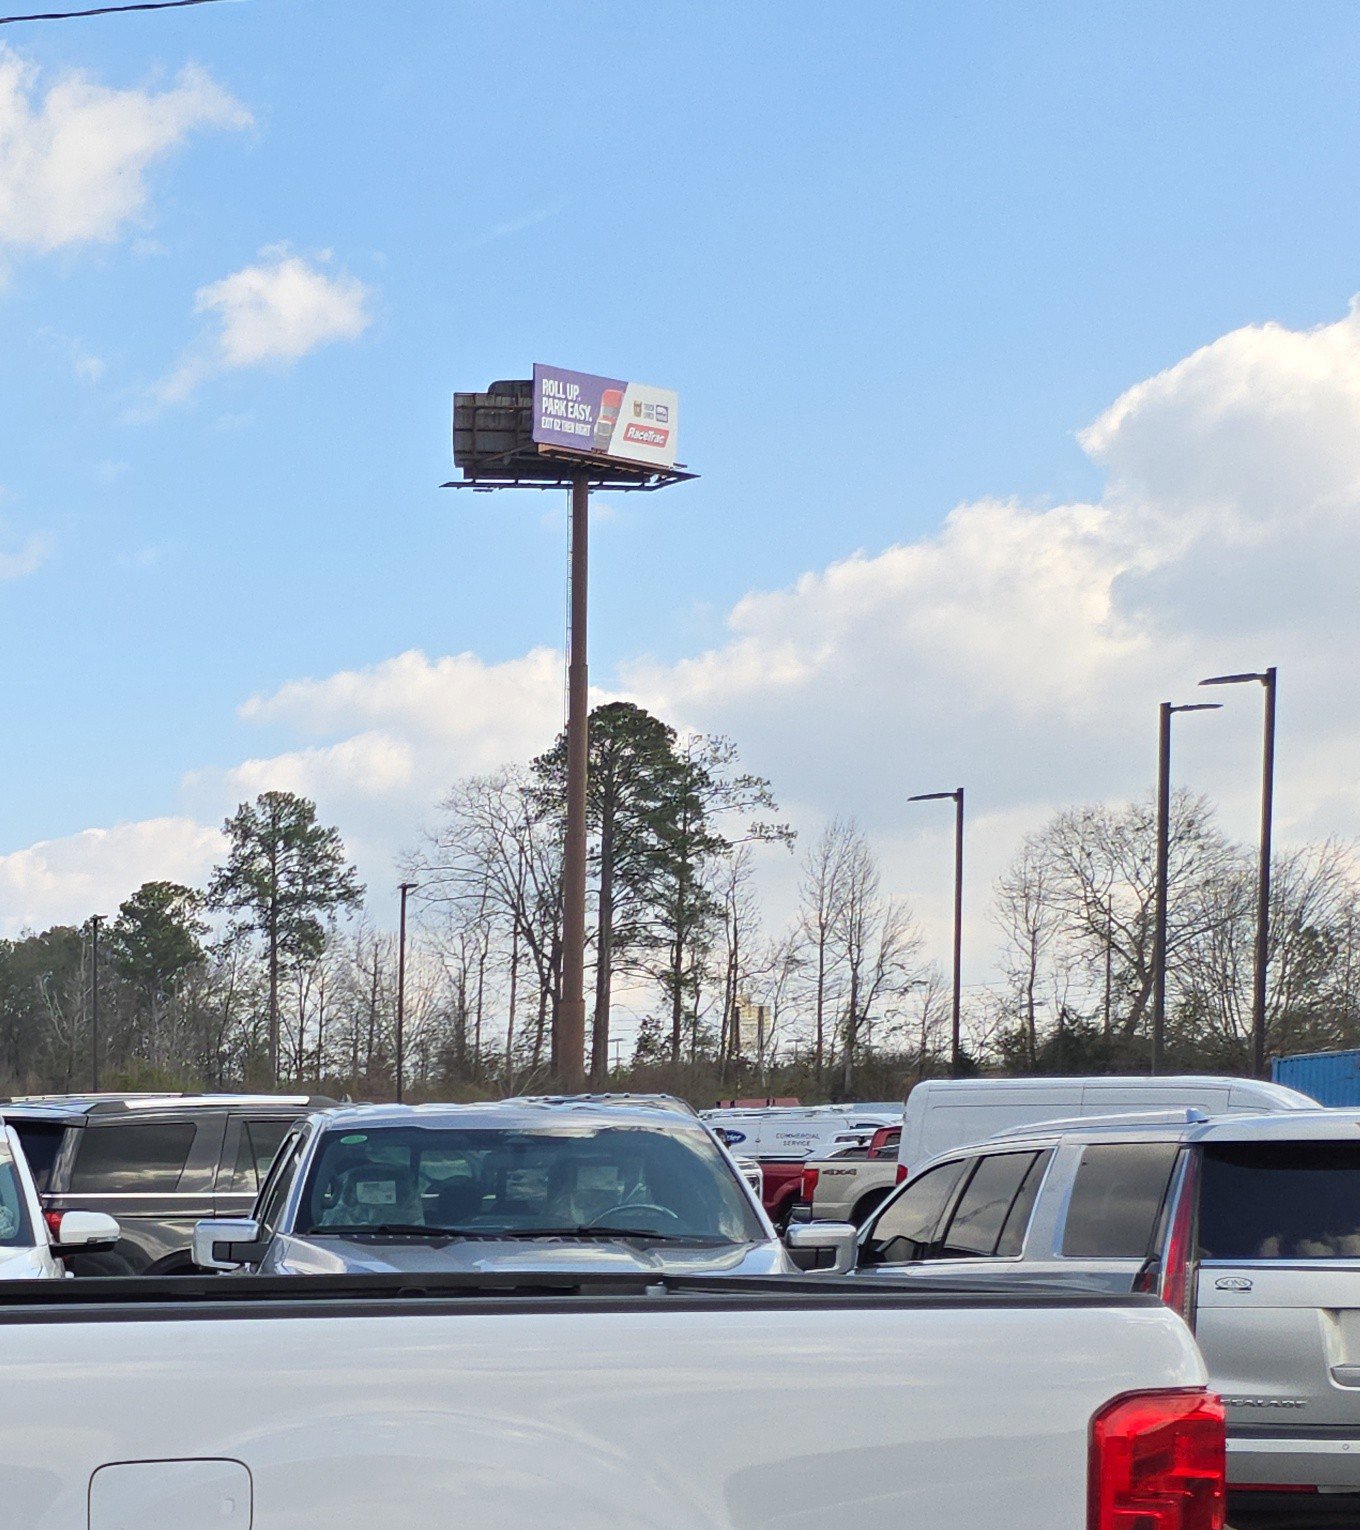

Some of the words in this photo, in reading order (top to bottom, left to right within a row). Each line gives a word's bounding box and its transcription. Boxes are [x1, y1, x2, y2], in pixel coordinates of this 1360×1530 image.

[542, 378, 566, 399] ROLL
[542, 397, 567, 418] PARK
[567, 401, 593, 422] EASY.
[1220, 1398, 1307, 1409] SCALADE
